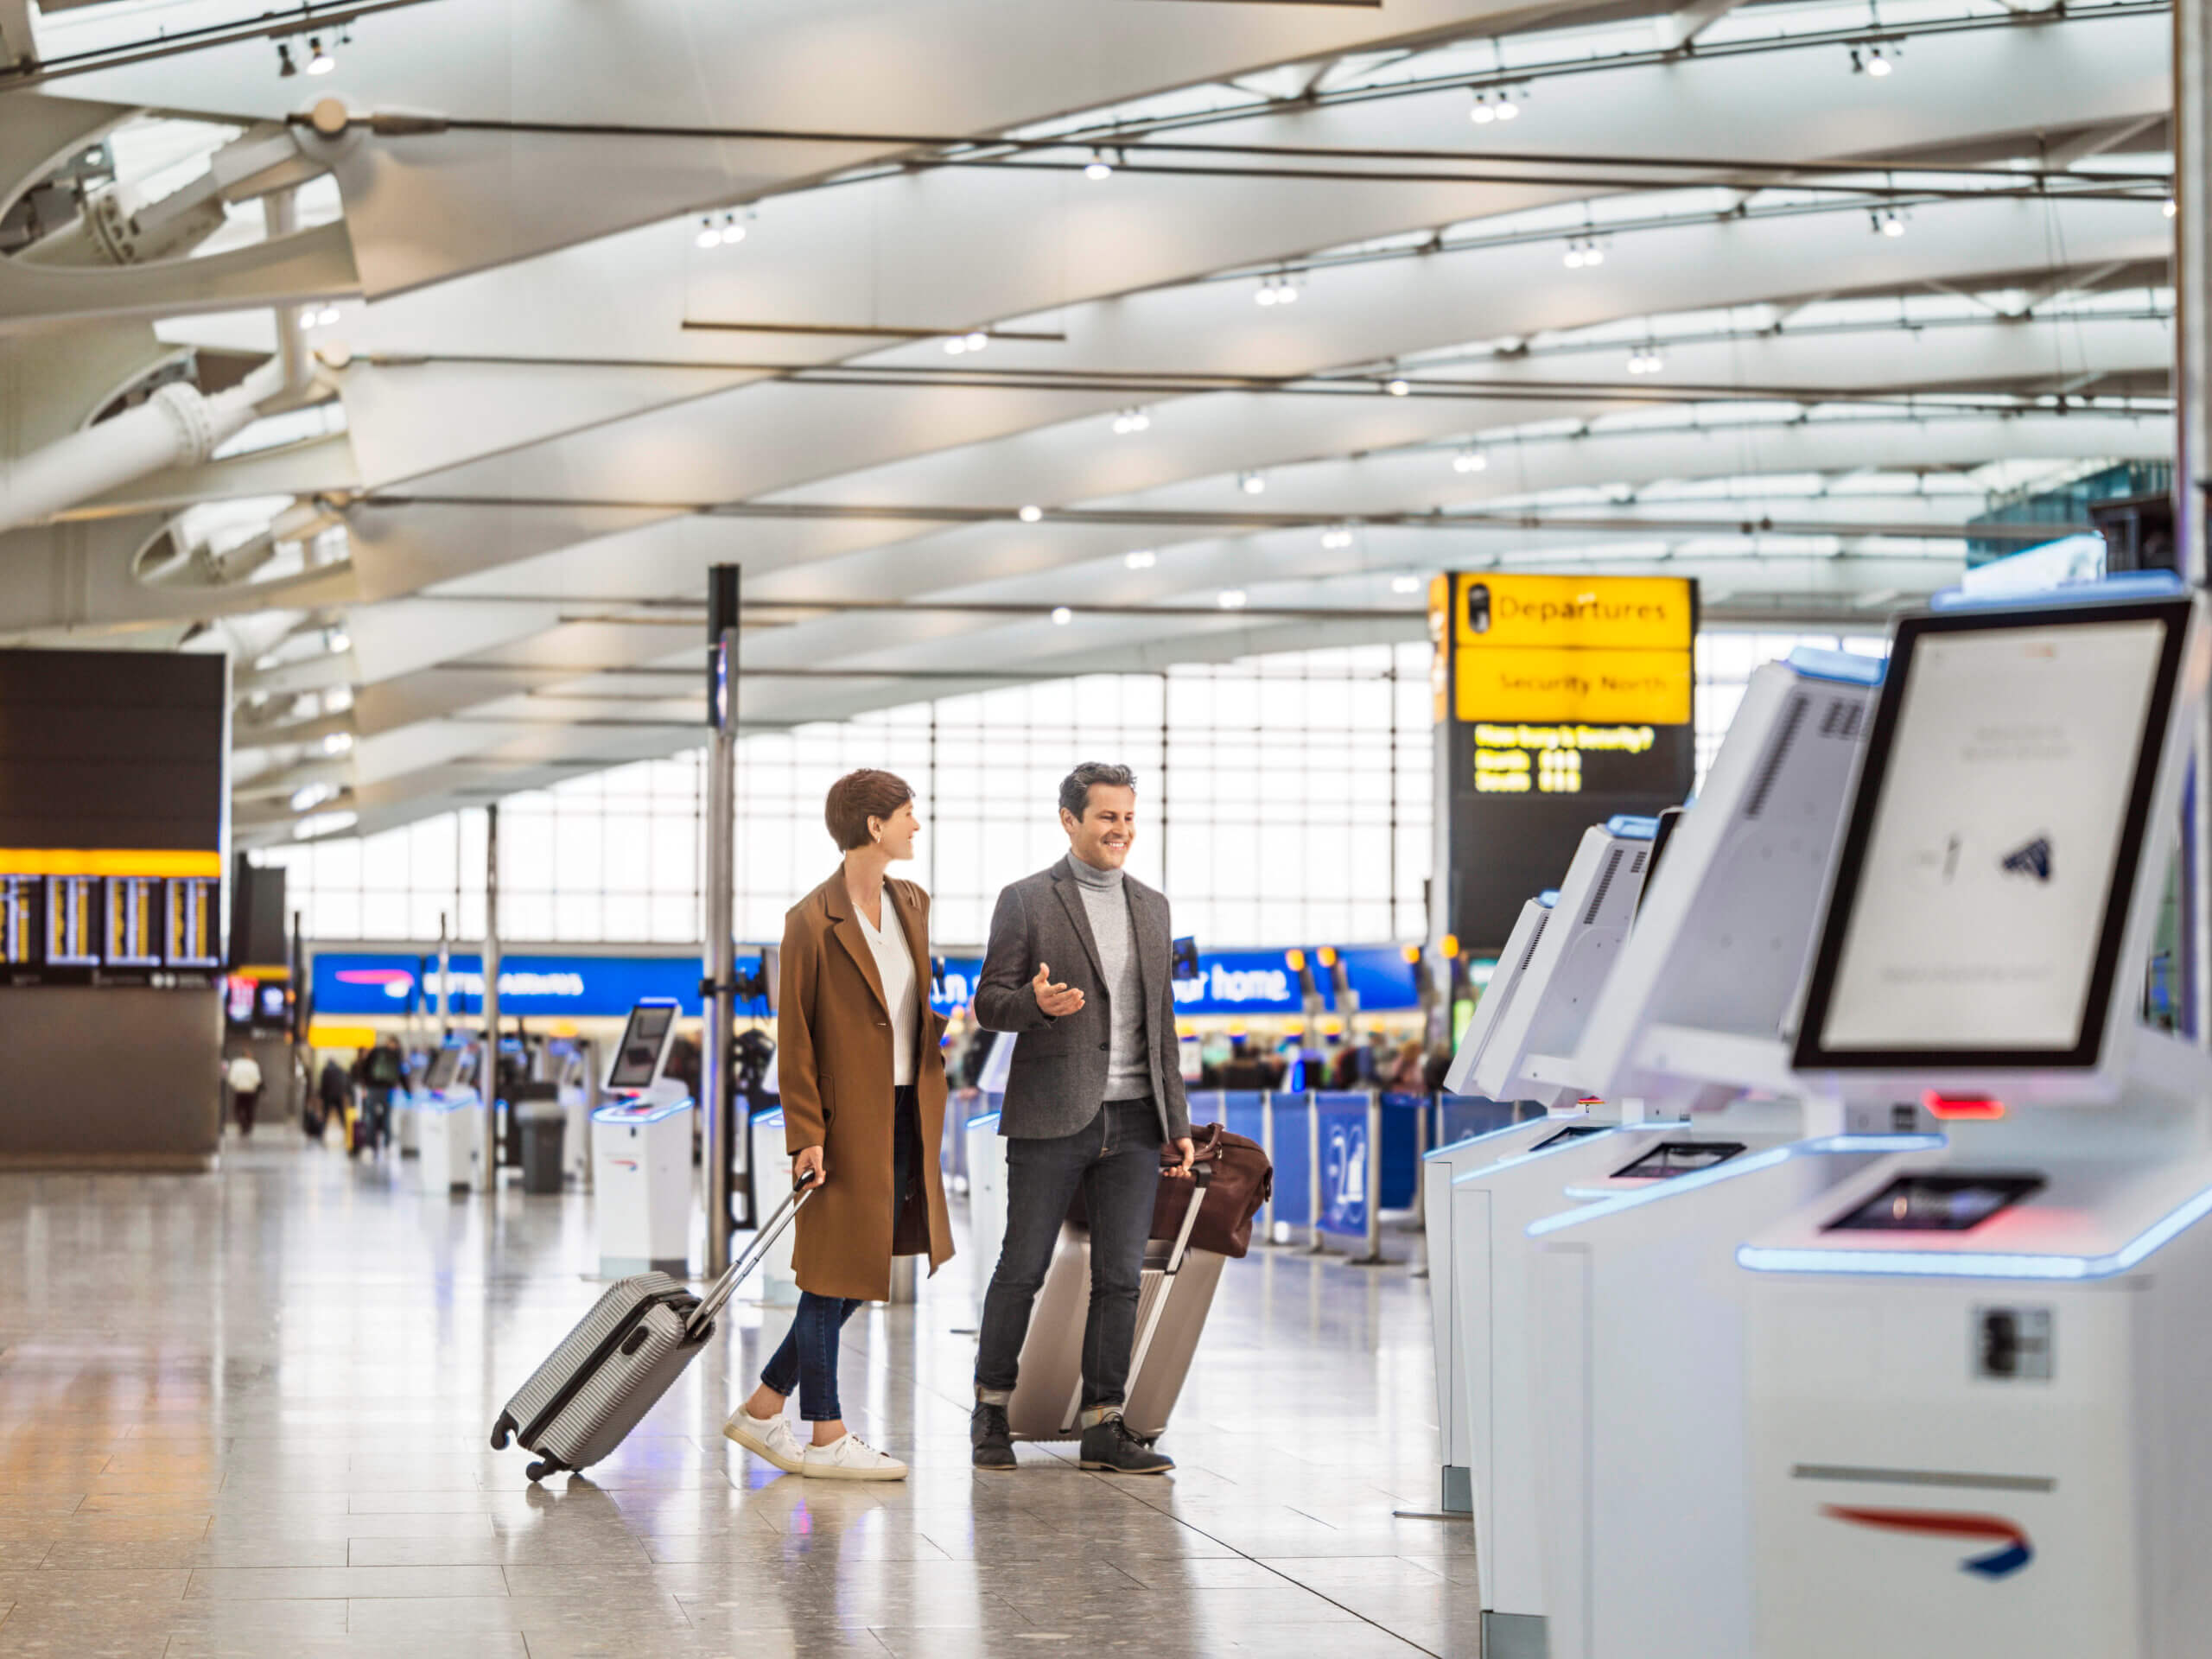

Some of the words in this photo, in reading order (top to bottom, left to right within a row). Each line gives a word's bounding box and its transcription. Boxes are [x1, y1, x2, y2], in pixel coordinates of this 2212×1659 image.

[1499, 595, 1667, 624] Departures
[1499, 673, 1590, 696] Security
[1600, 674, 1667, 692] North
